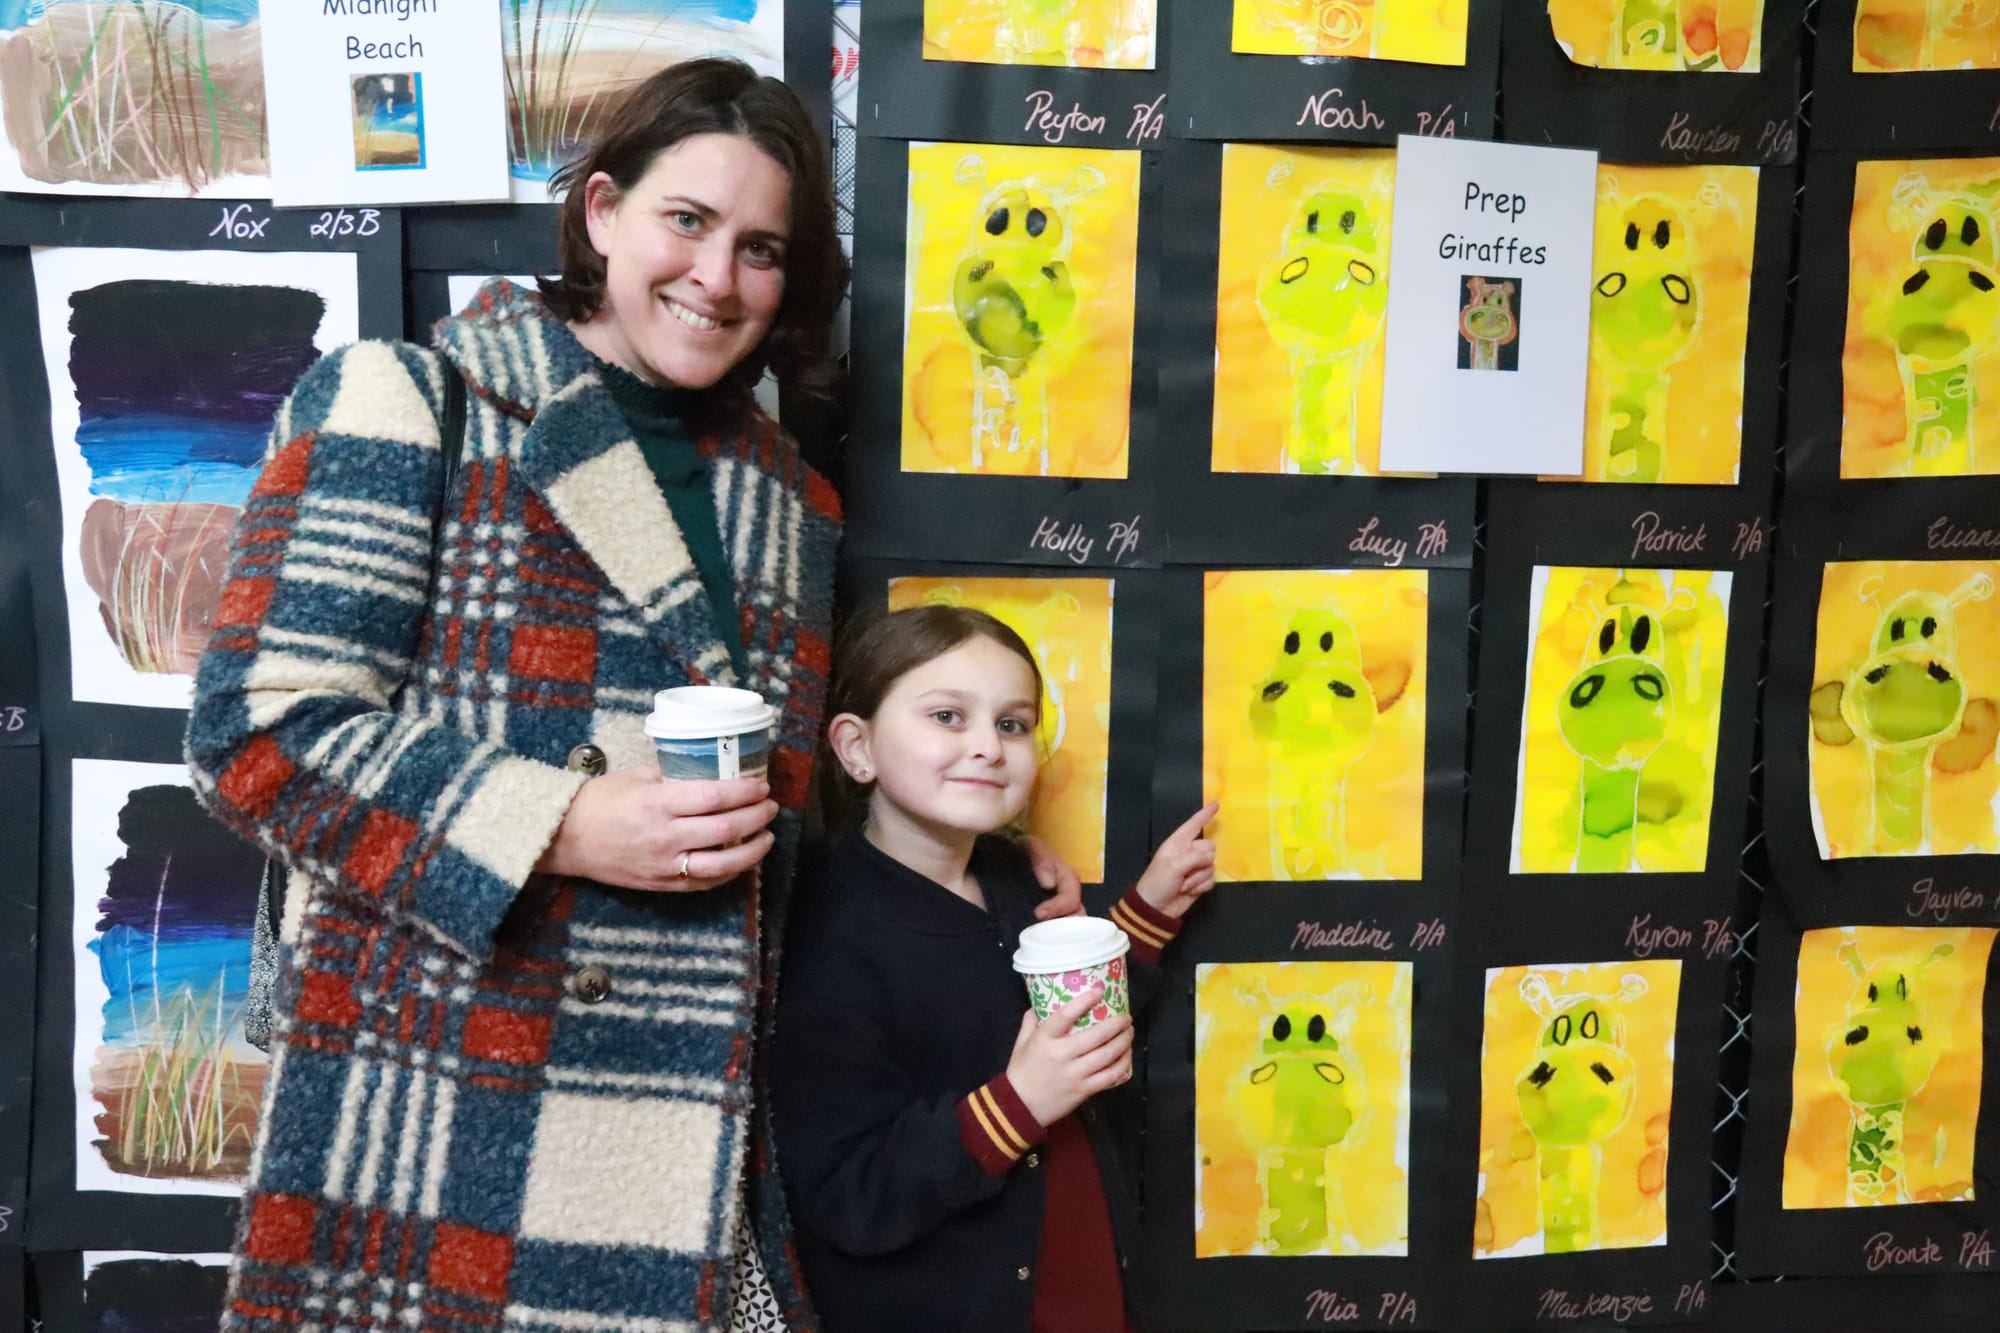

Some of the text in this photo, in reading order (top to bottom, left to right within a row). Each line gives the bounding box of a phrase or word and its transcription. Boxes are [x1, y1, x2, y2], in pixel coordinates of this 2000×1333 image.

[346, 34, 423, 59] Beach
[1025, 90, 1166, 146] Peyton P/A
[1296, 88, 1455, 138] Noah P/A
[1660, 112, 1741, 161] Kayden
[209, 204, 270, 239] Nox
[1465, 182, 1526, 223] Prep
[1439, 233, 1547, 265] Giraffes
[1106, 514, 1140, 564] P/A
[1349, 517, 1448, 567] Lucy P/A
[1631, 511, 1763, 560] Patrick P/A
[1290, 918, 1446, 951] Madeline P/A
[1625, 913, 1732, 960] Kyron P/A
[1863, 1229, 1996, 1271] Bronte P/A
[1306, 1289, 1416, 1325] Mia P/A
[1536, 1280, 1706, 1322] Mackenzie P/A
